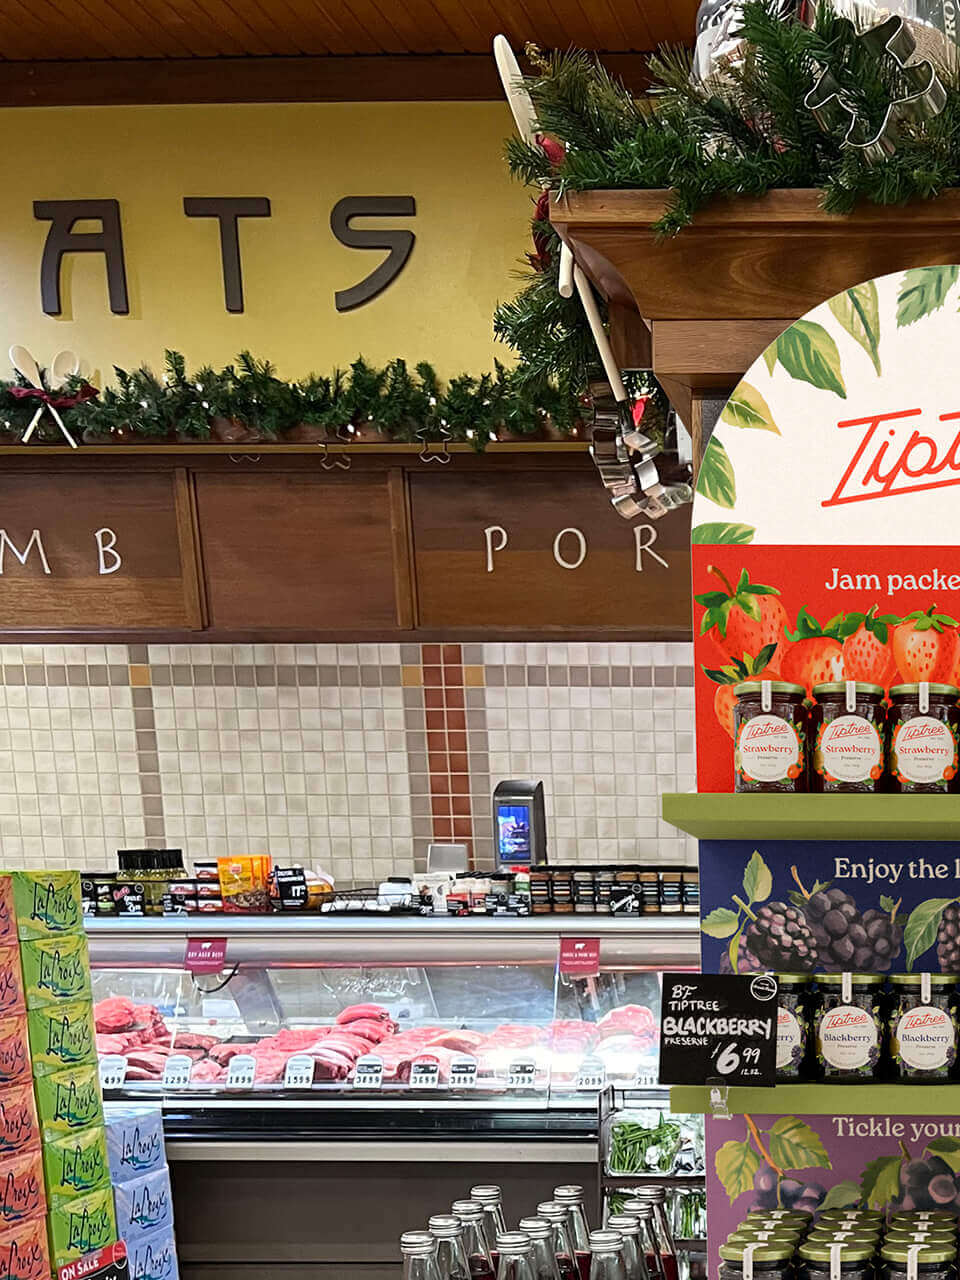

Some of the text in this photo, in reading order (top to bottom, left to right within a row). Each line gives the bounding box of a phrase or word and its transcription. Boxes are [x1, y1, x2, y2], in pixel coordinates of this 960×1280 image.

[825, 569, 882, 592] Jam
[746, 722, 790, 740] Tiptree
[829, 722, 873, 740] Tiptree
[902, 723, 945, 741] Tiptree
[743, 744, 793, 756] Strawberry
[825, 744, 876, 756] Strawberry
[899, 745, 950, 757] Strawberry
[834, 857, 904, 884] Enjoy
[910, 858, 948, 880] the
[668, 1000, 720, 1011] TIPTREE
[663, 1016, 772, 1040] BLACKBERRY
[826, 1013, 868, 1030] Tiptree
[664, 1037, 709, 1046] PRESERVE
[823, 1033, 872, 1043] Blackberry
[833, 1116, 905, 1138] Tickle
[78, 1258, 100, 1275] SALE
